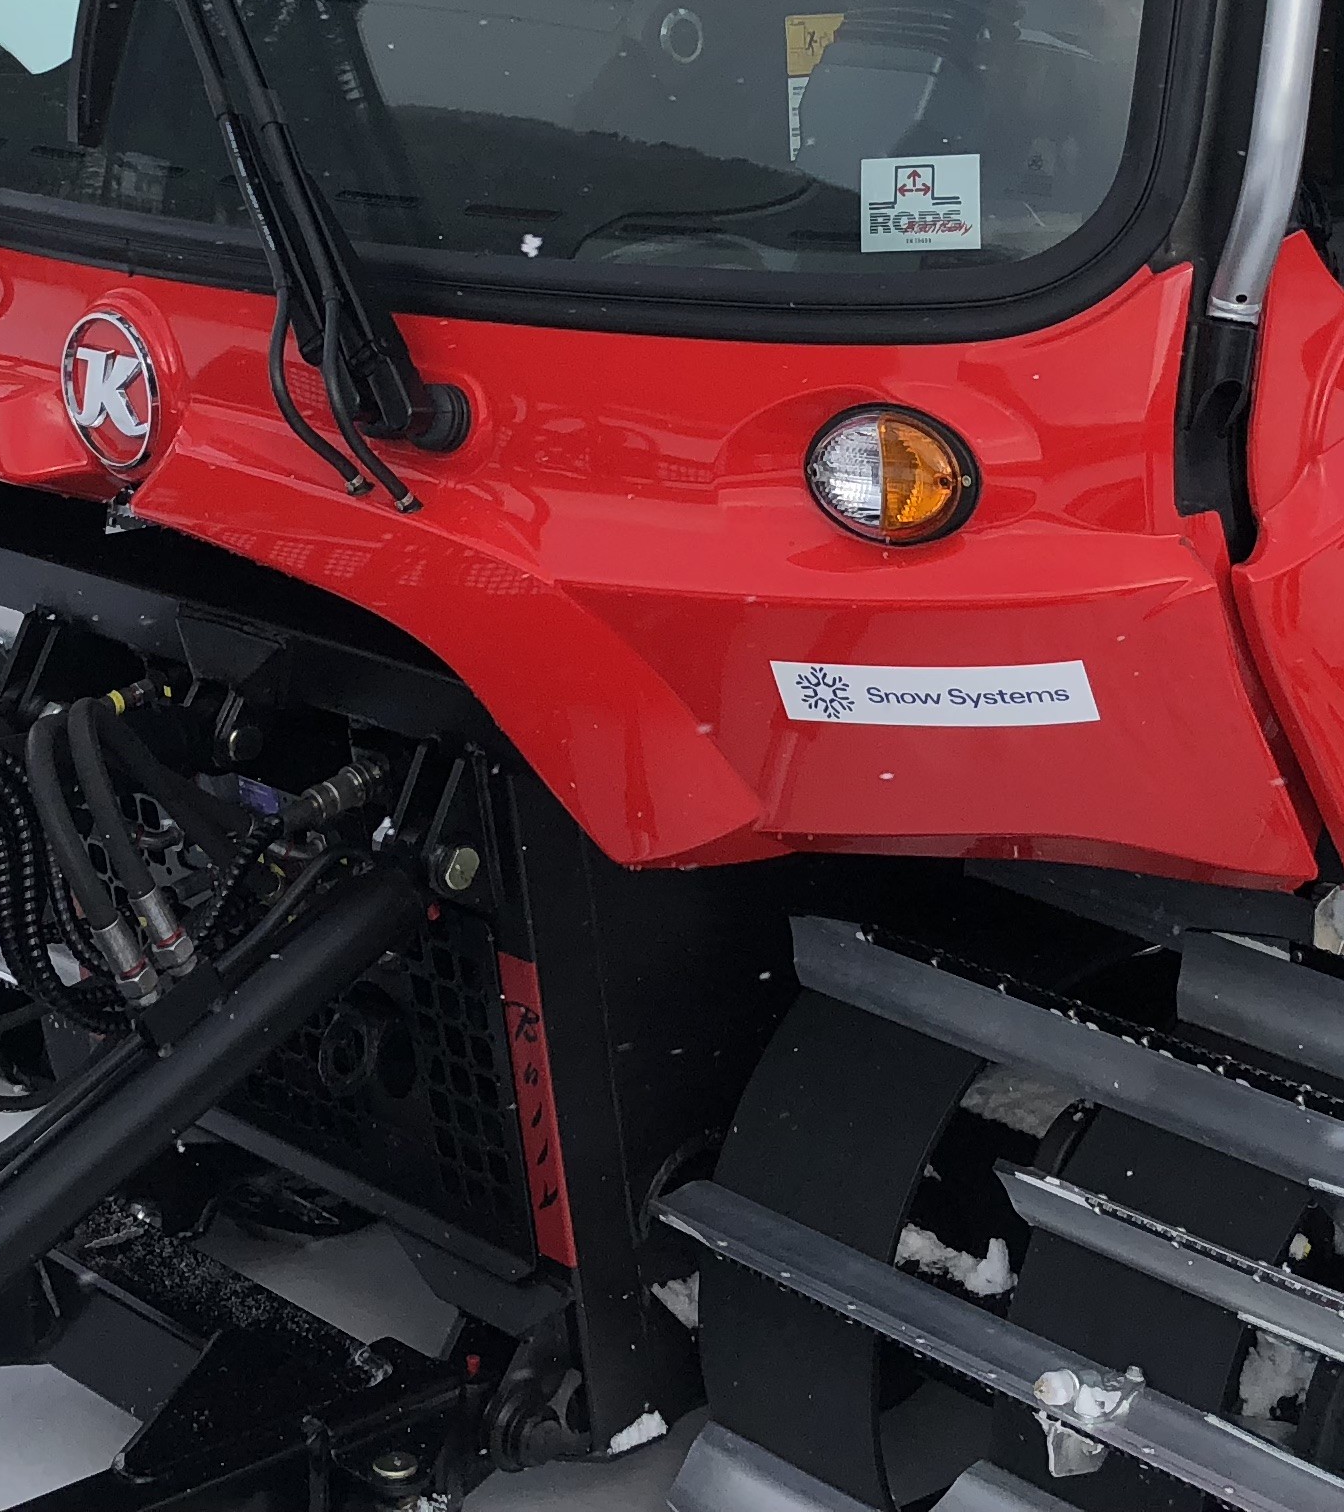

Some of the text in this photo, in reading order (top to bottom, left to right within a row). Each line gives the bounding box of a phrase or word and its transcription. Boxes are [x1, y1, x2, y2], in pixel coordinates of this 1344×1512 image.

[76, 346, 148, 436] K
[865, 686, 1070, 709] Snow Systems
